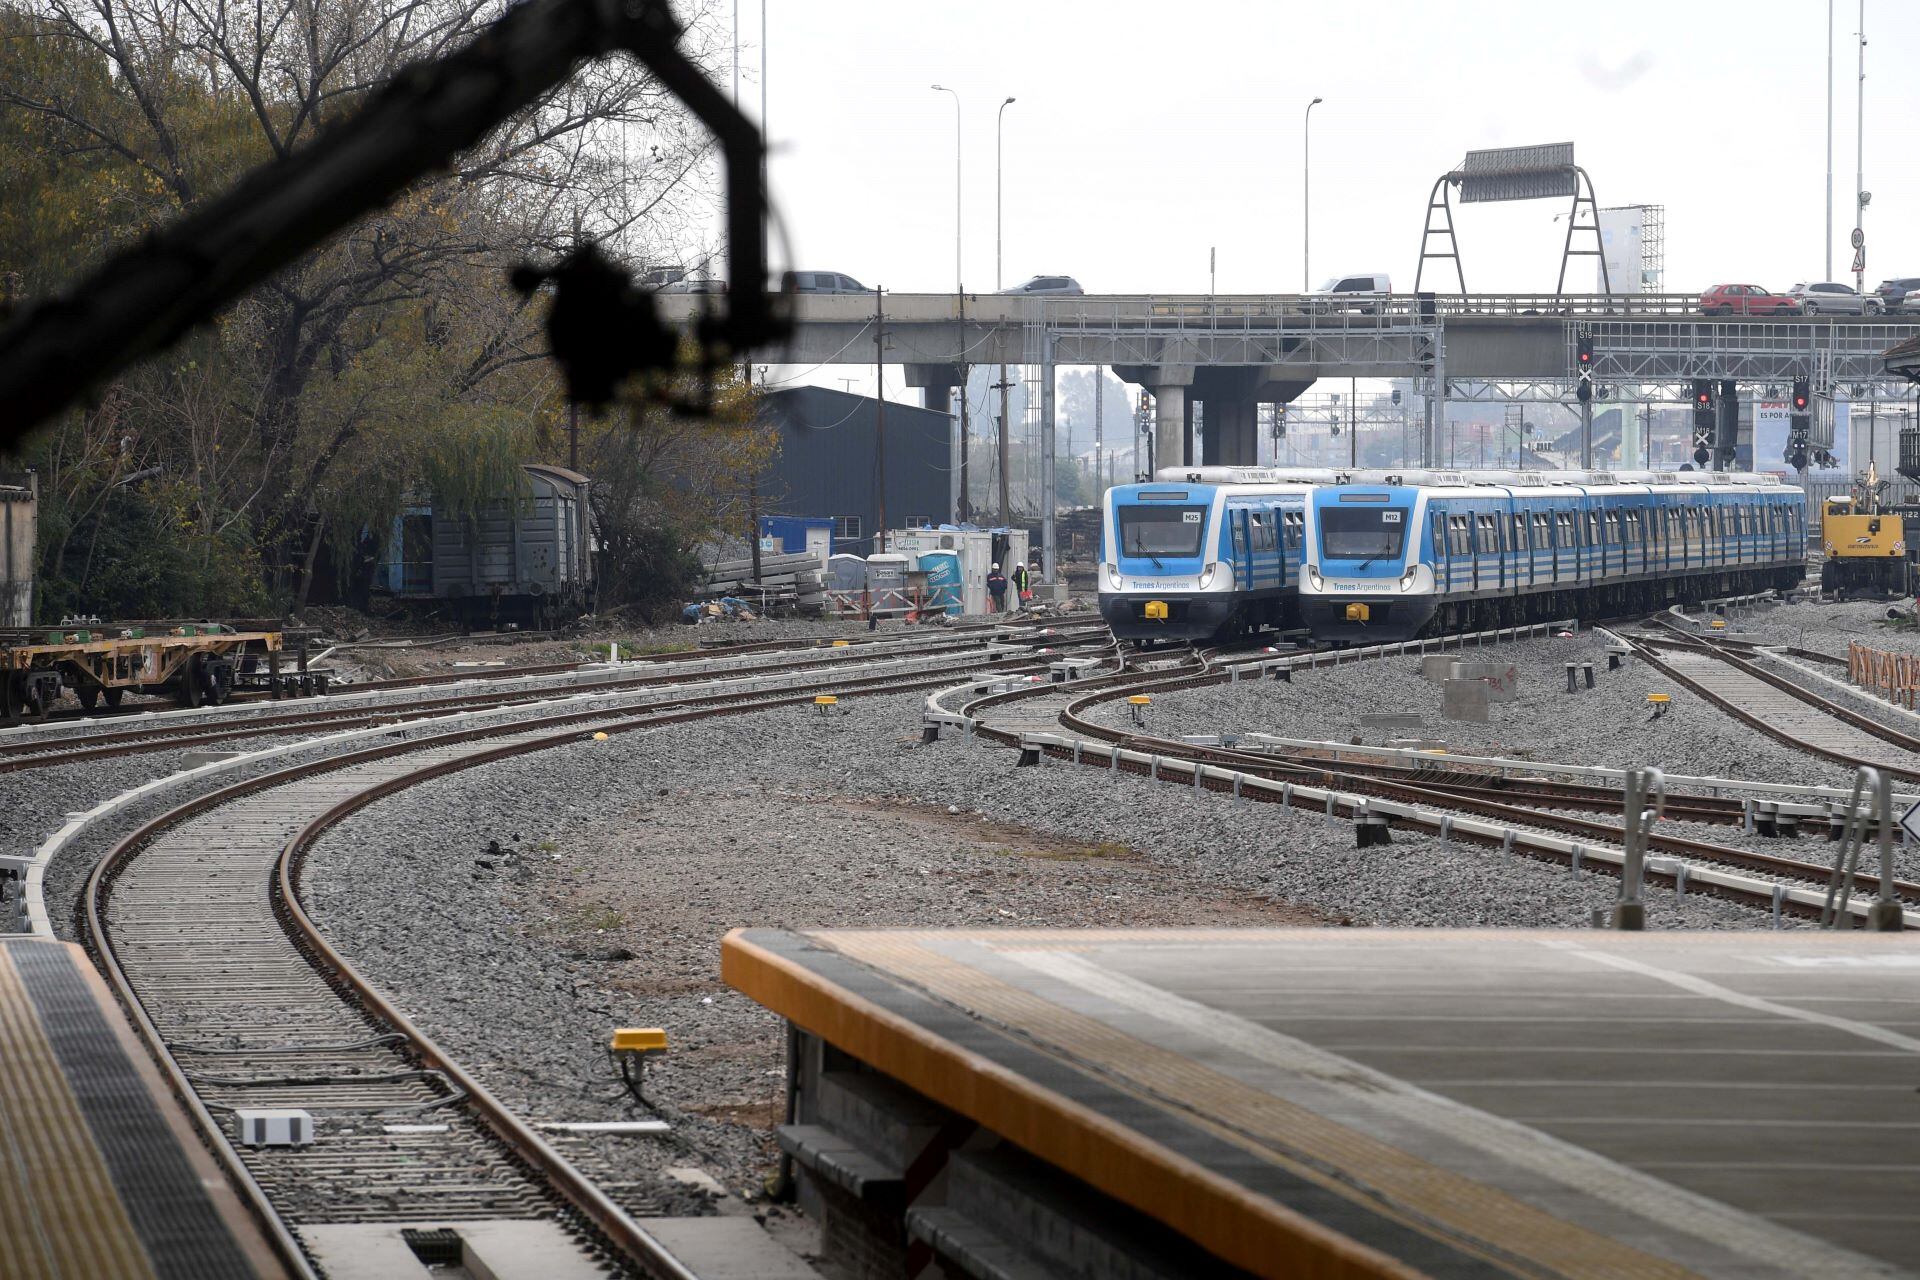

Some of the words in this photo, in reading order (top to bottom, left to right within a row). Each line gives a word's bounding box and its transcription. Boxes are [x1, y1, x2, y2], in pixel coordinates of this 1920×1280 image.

[1579, 331, 1593, 339] S19
[1795, 375, 1808, 383] S17
[1792, 431, 1807, 439] M17
[1132, 581, 1155, 589] Trenes
[1155, 581, 1190, 591] Argentinos
[1334, 583, 1356, 591] Trenes
[1356, 583, 1391, 592] Argentinos
